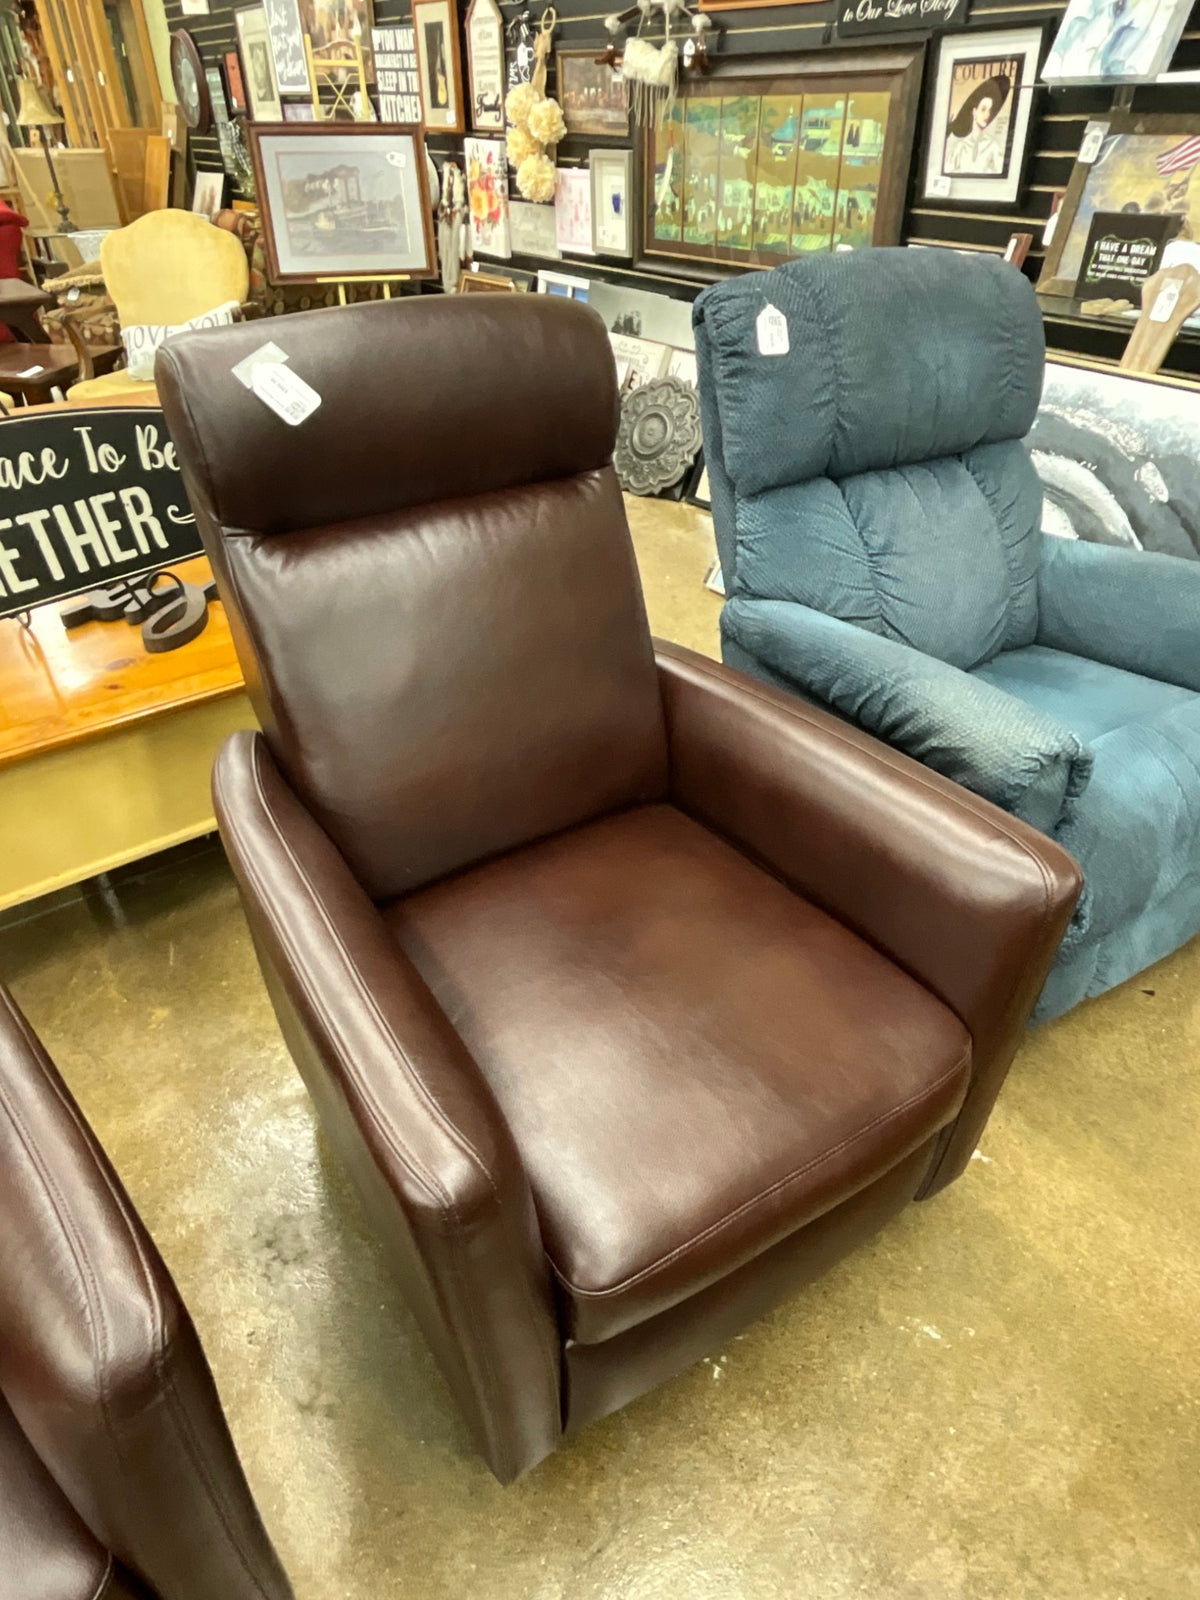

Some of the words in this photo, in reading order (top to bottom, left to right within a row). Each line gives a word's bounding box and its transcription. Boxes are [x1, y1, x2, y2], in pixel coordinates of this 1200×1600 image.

[843, 8, 854, 22] to
[856, 0, 882, 21] Our
[884, 0, 917, 18] Love
[376, 71, 398, 91] SLEEP
[398, 72, 408, 92] IN
[953, 60, 1017, 84] COUTURE
[1099, 253, 1116, 263] THAT
[1116, 255, 1130, 264] ONE
[1100, 241, 1120, 253] HAVE
[1121, 243, 1128, 253] A
[1130, 244, 1157, 256] DREAM
[73, 426, 126, 473] To
[135, 424, 181, 471] Be
[0, 486, 170, 597] ETHER
